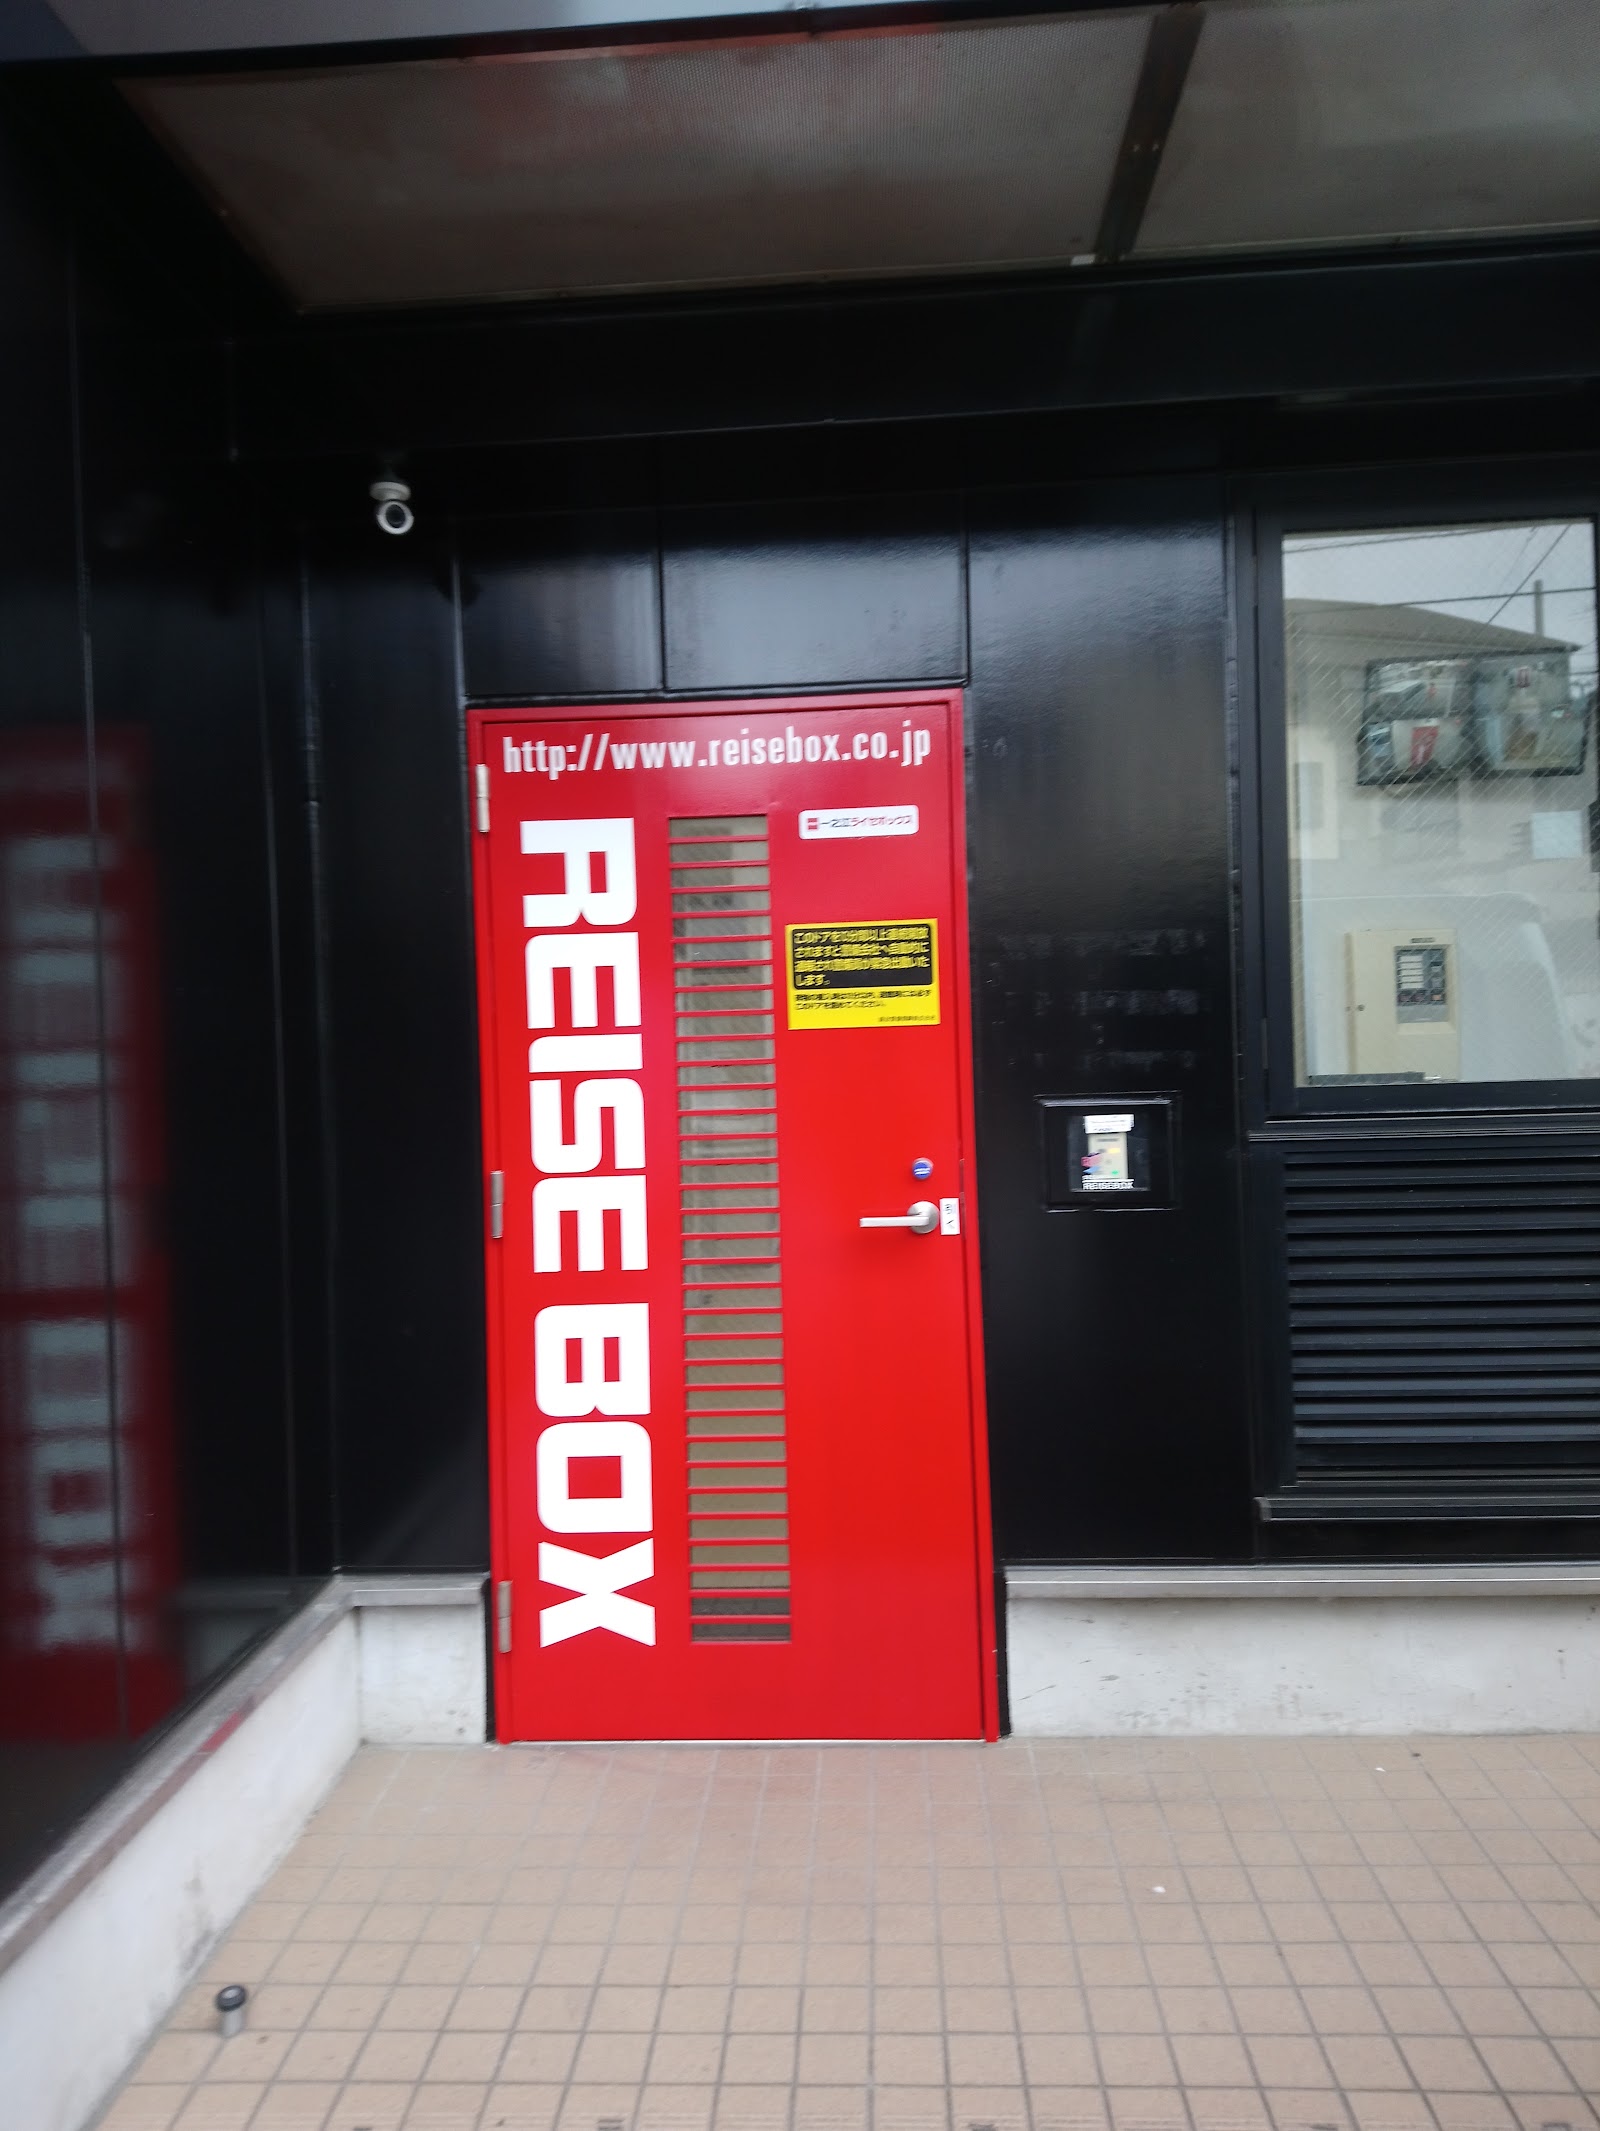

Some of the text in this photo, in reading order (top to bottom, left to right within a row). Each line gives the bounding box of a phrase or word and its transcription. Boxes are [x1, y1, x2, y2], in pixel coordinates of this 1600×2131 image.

[502, 720, 931, 780] http://www.reisebox.co.jp
[795, 973, 831, 987] します。
